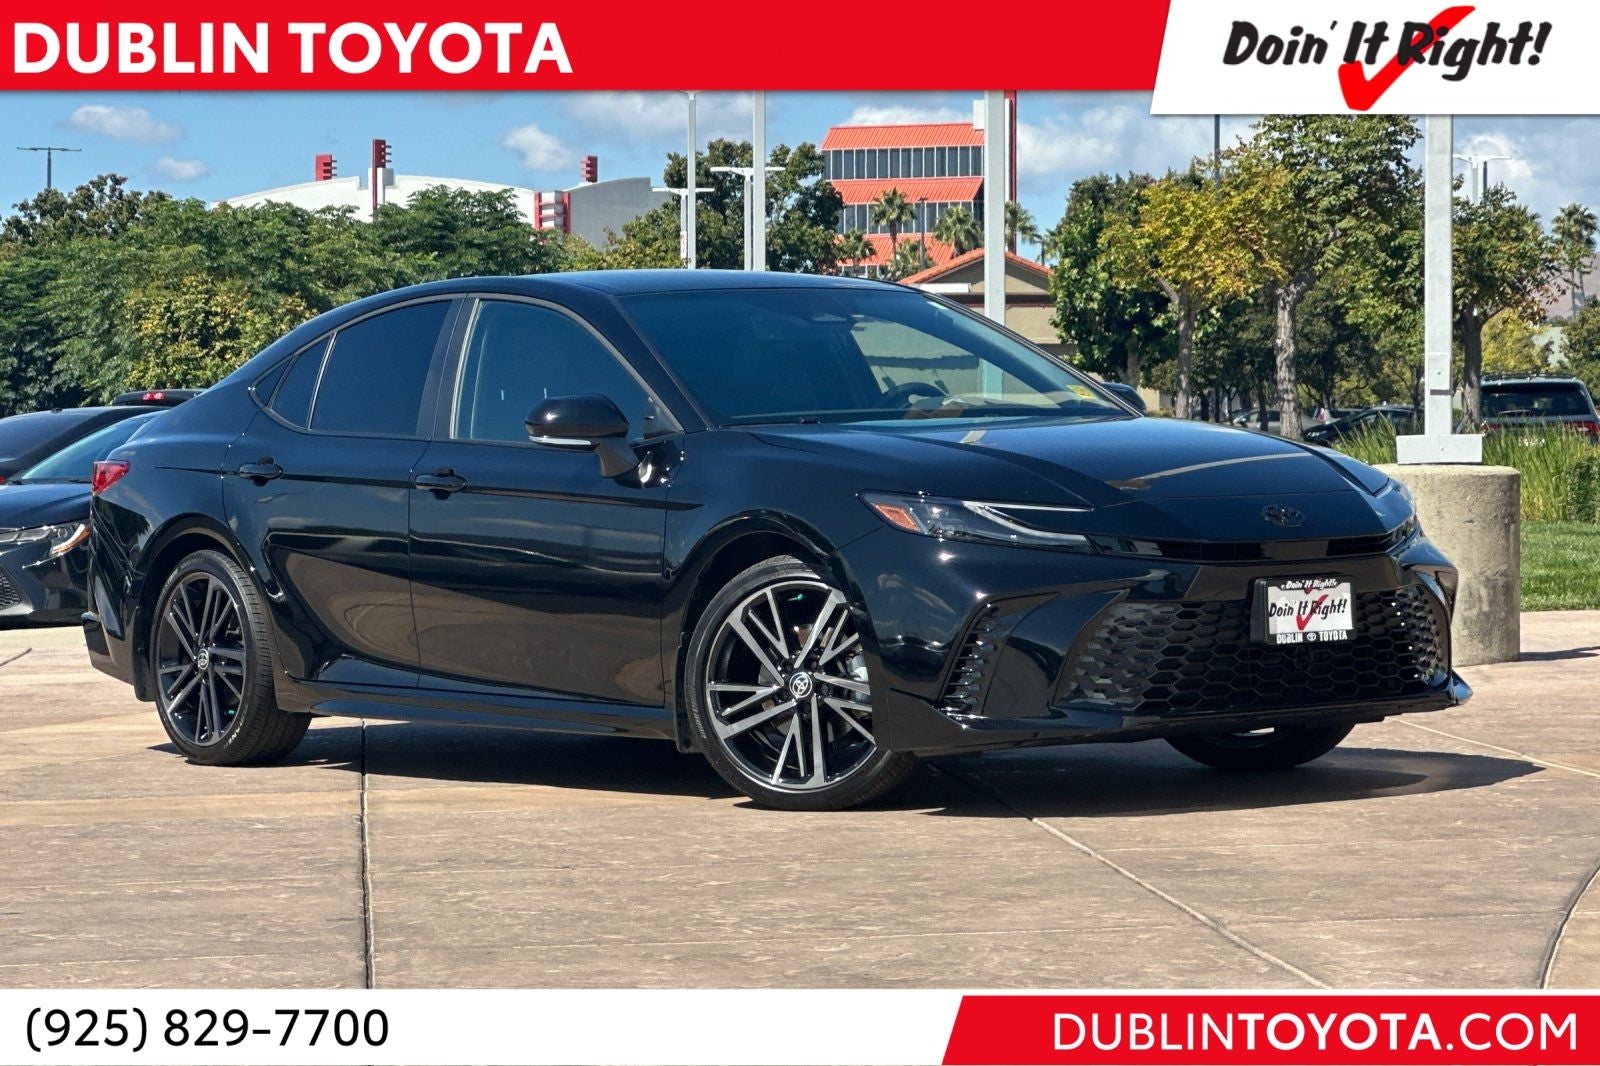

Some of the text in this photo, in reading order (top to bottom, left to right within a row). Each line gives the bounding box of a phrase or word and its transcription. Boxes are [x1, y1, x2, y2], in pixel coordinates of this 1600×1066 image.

[1269, 598, 1348, 620] Doin' It Right!
[1276, 629, 1348, 645] DUBLIN TOYOTA
